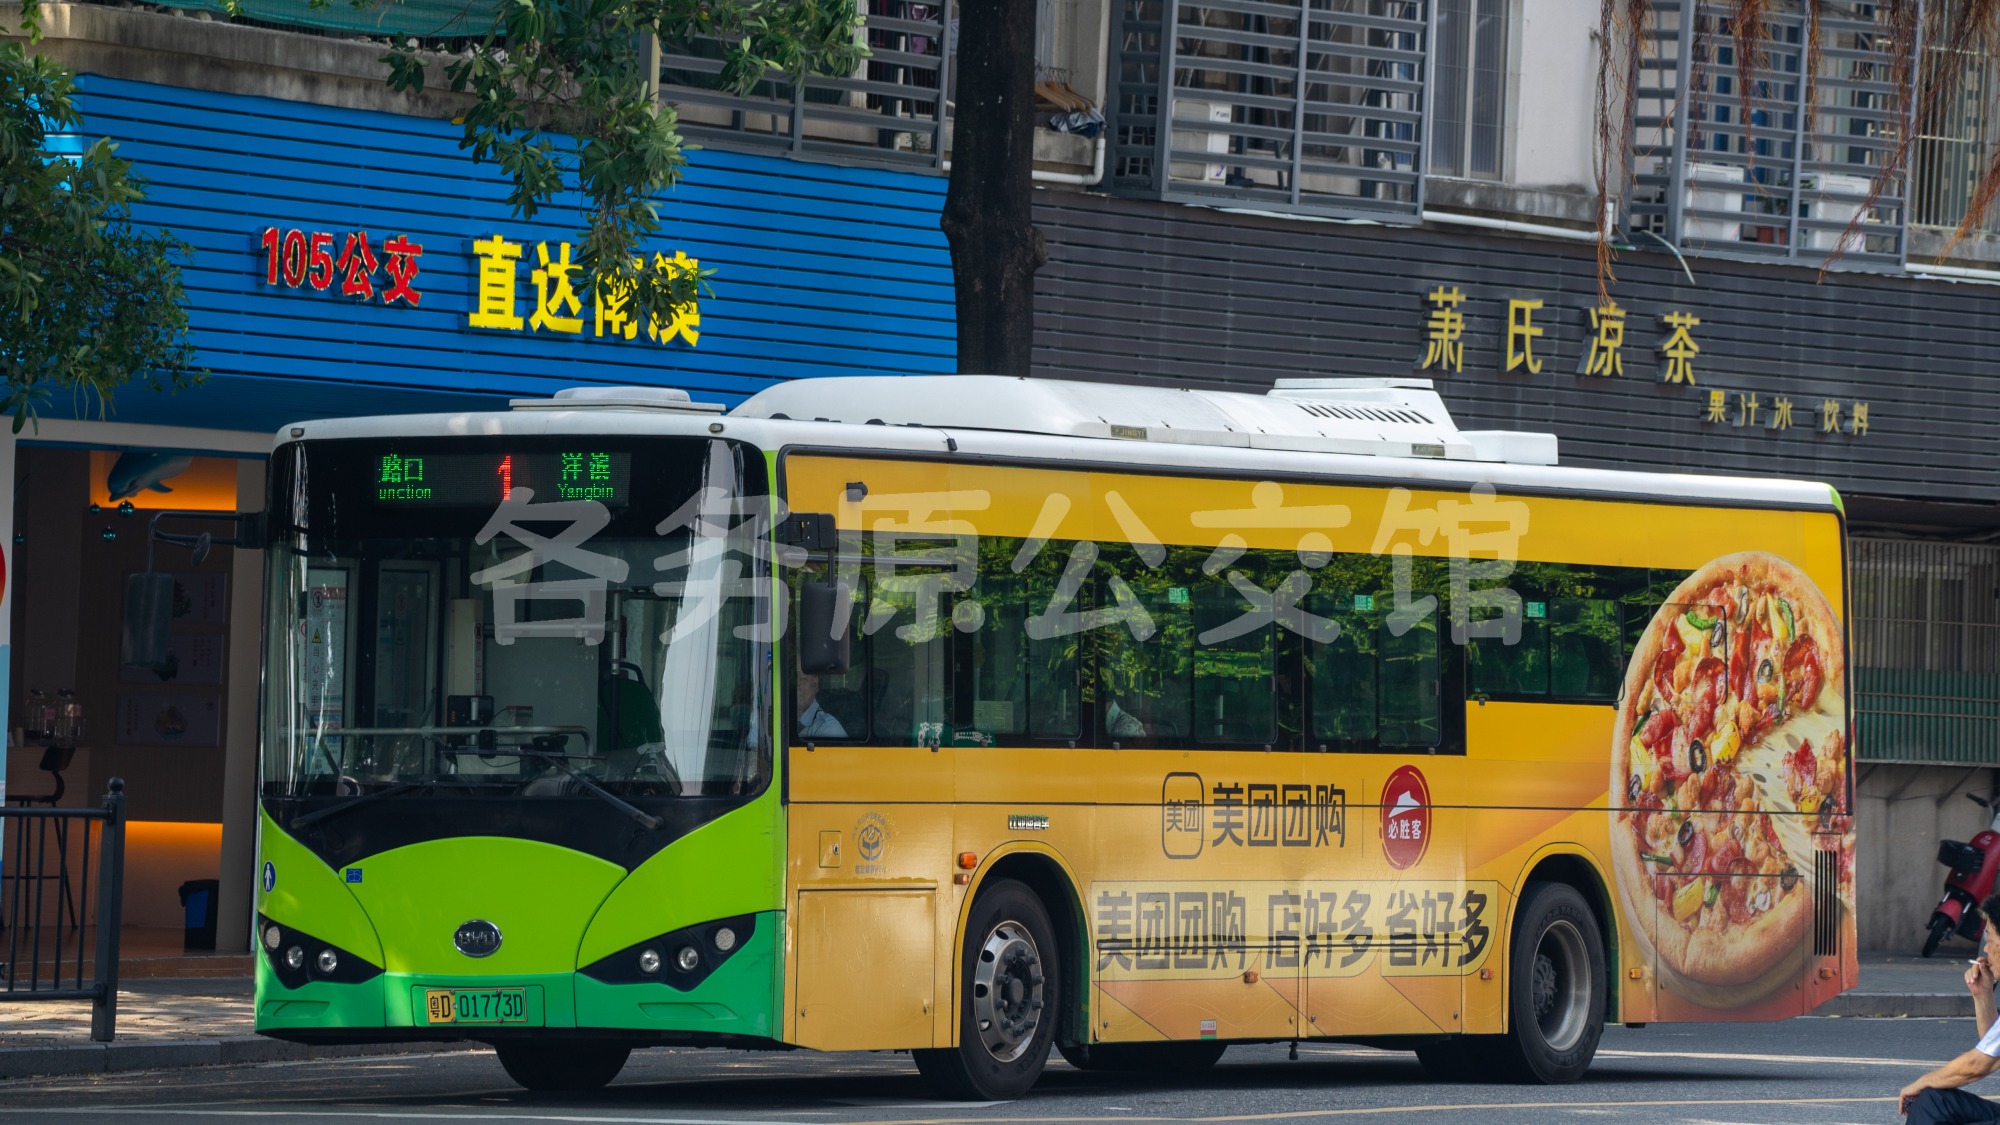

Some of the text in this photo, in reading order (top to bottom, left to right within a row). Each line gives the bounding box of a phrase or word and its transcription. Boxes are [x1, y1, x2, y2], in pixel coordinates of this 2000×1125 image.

[262, 227, 423, 306] 105公交
[1422, 286, 1700, 385] 萧氏凉茶
[381, 454, 423, 482] 路口
[498, 456, 511, 500] 1
[561, 453, 610, 480] 洋滨
[380, 485, 431, 499] unction
[558, 484, 614, 501] Yangbin
[1167, 782, 1345, 848] 美团 美团团购
[1388, 818, 1422, 840] 必胜客
[459, 930, 496, 946] BYD
[1096, 889, 1489, 971] 美团团购 店好多 省好多
